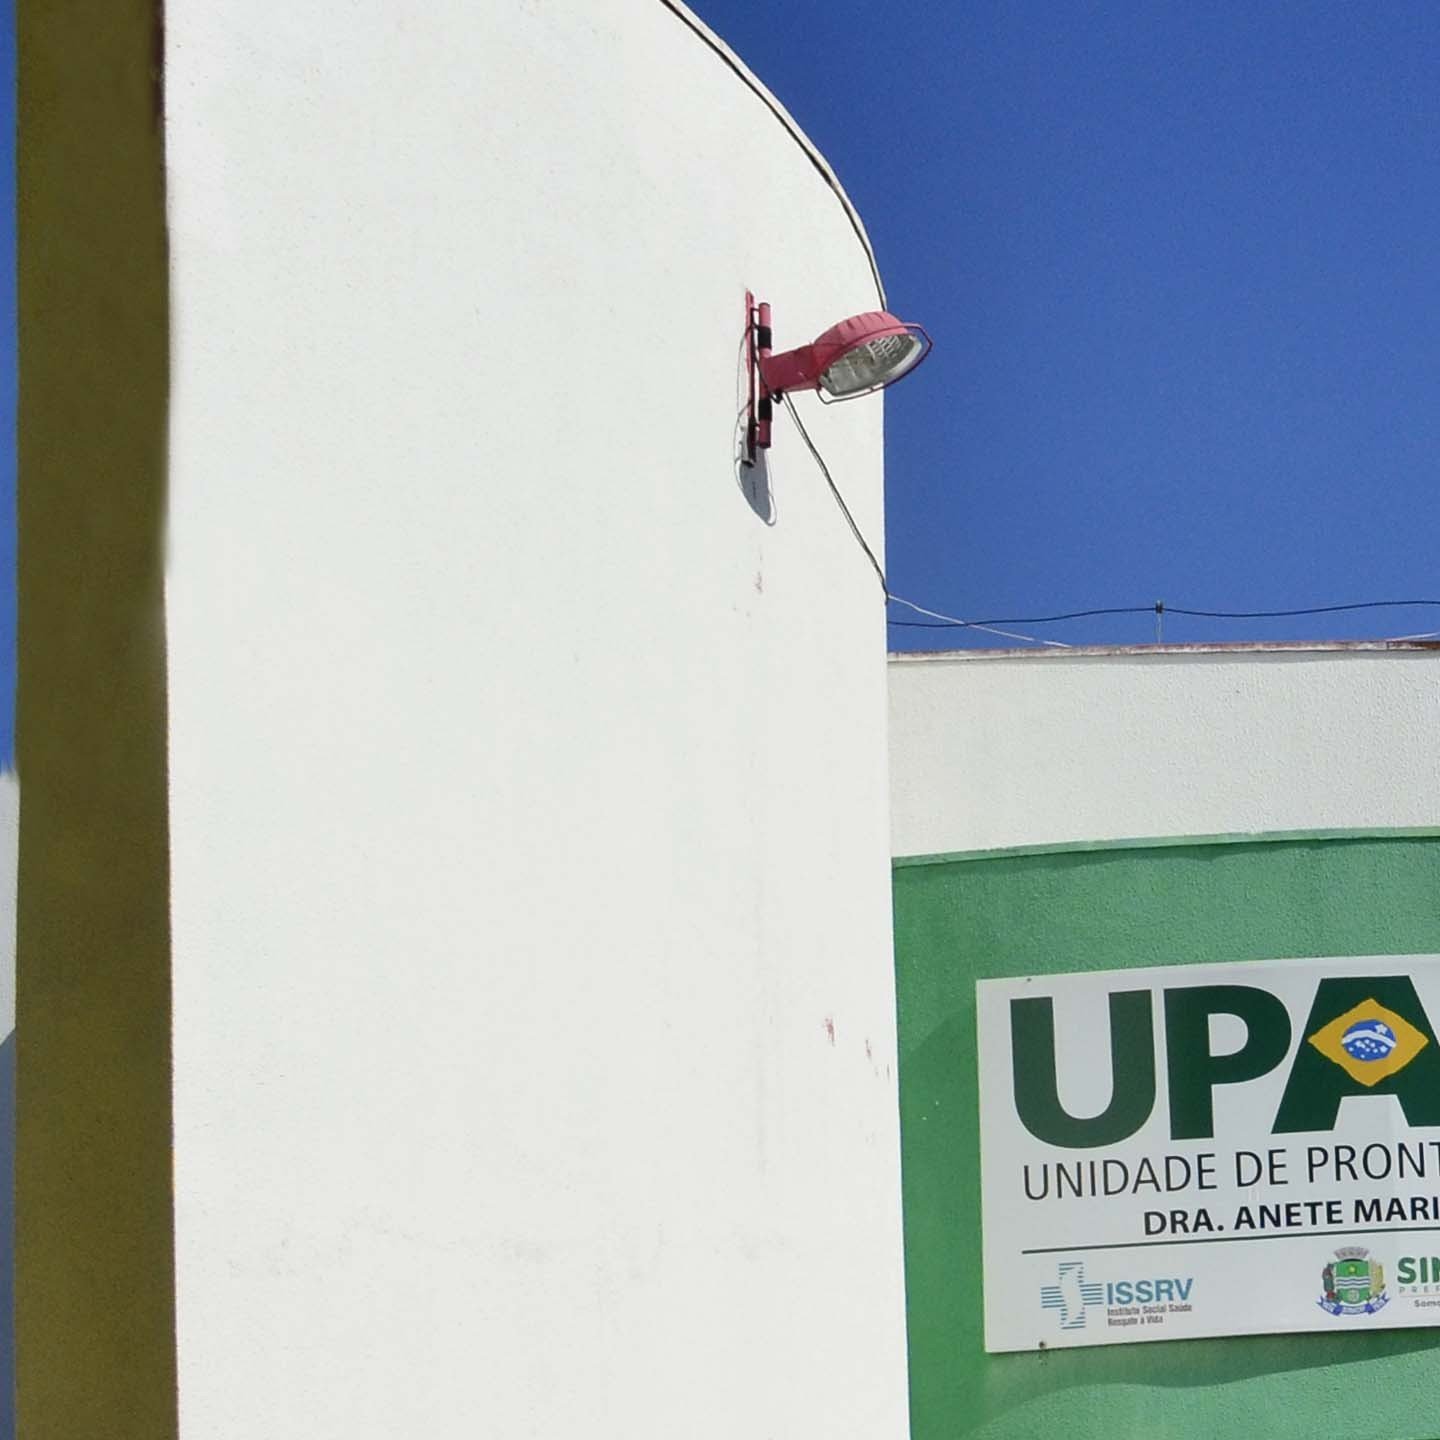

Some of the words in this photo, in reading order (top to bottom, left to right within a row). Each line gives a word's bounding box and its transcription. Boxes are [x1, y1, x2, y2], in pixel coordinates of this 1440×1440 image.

[1024, 1153, 1217, 1200] UNIDADE
[1235, 1149, 1288, 1188] DE
[1144, 1208, 1224, 1236] DRA.
[1234, 1200, 1343, 1230] ANETE
[1107, 1278, 1194, 1305] ISSRV
[1143, 1305, 1167, 1314] Social
